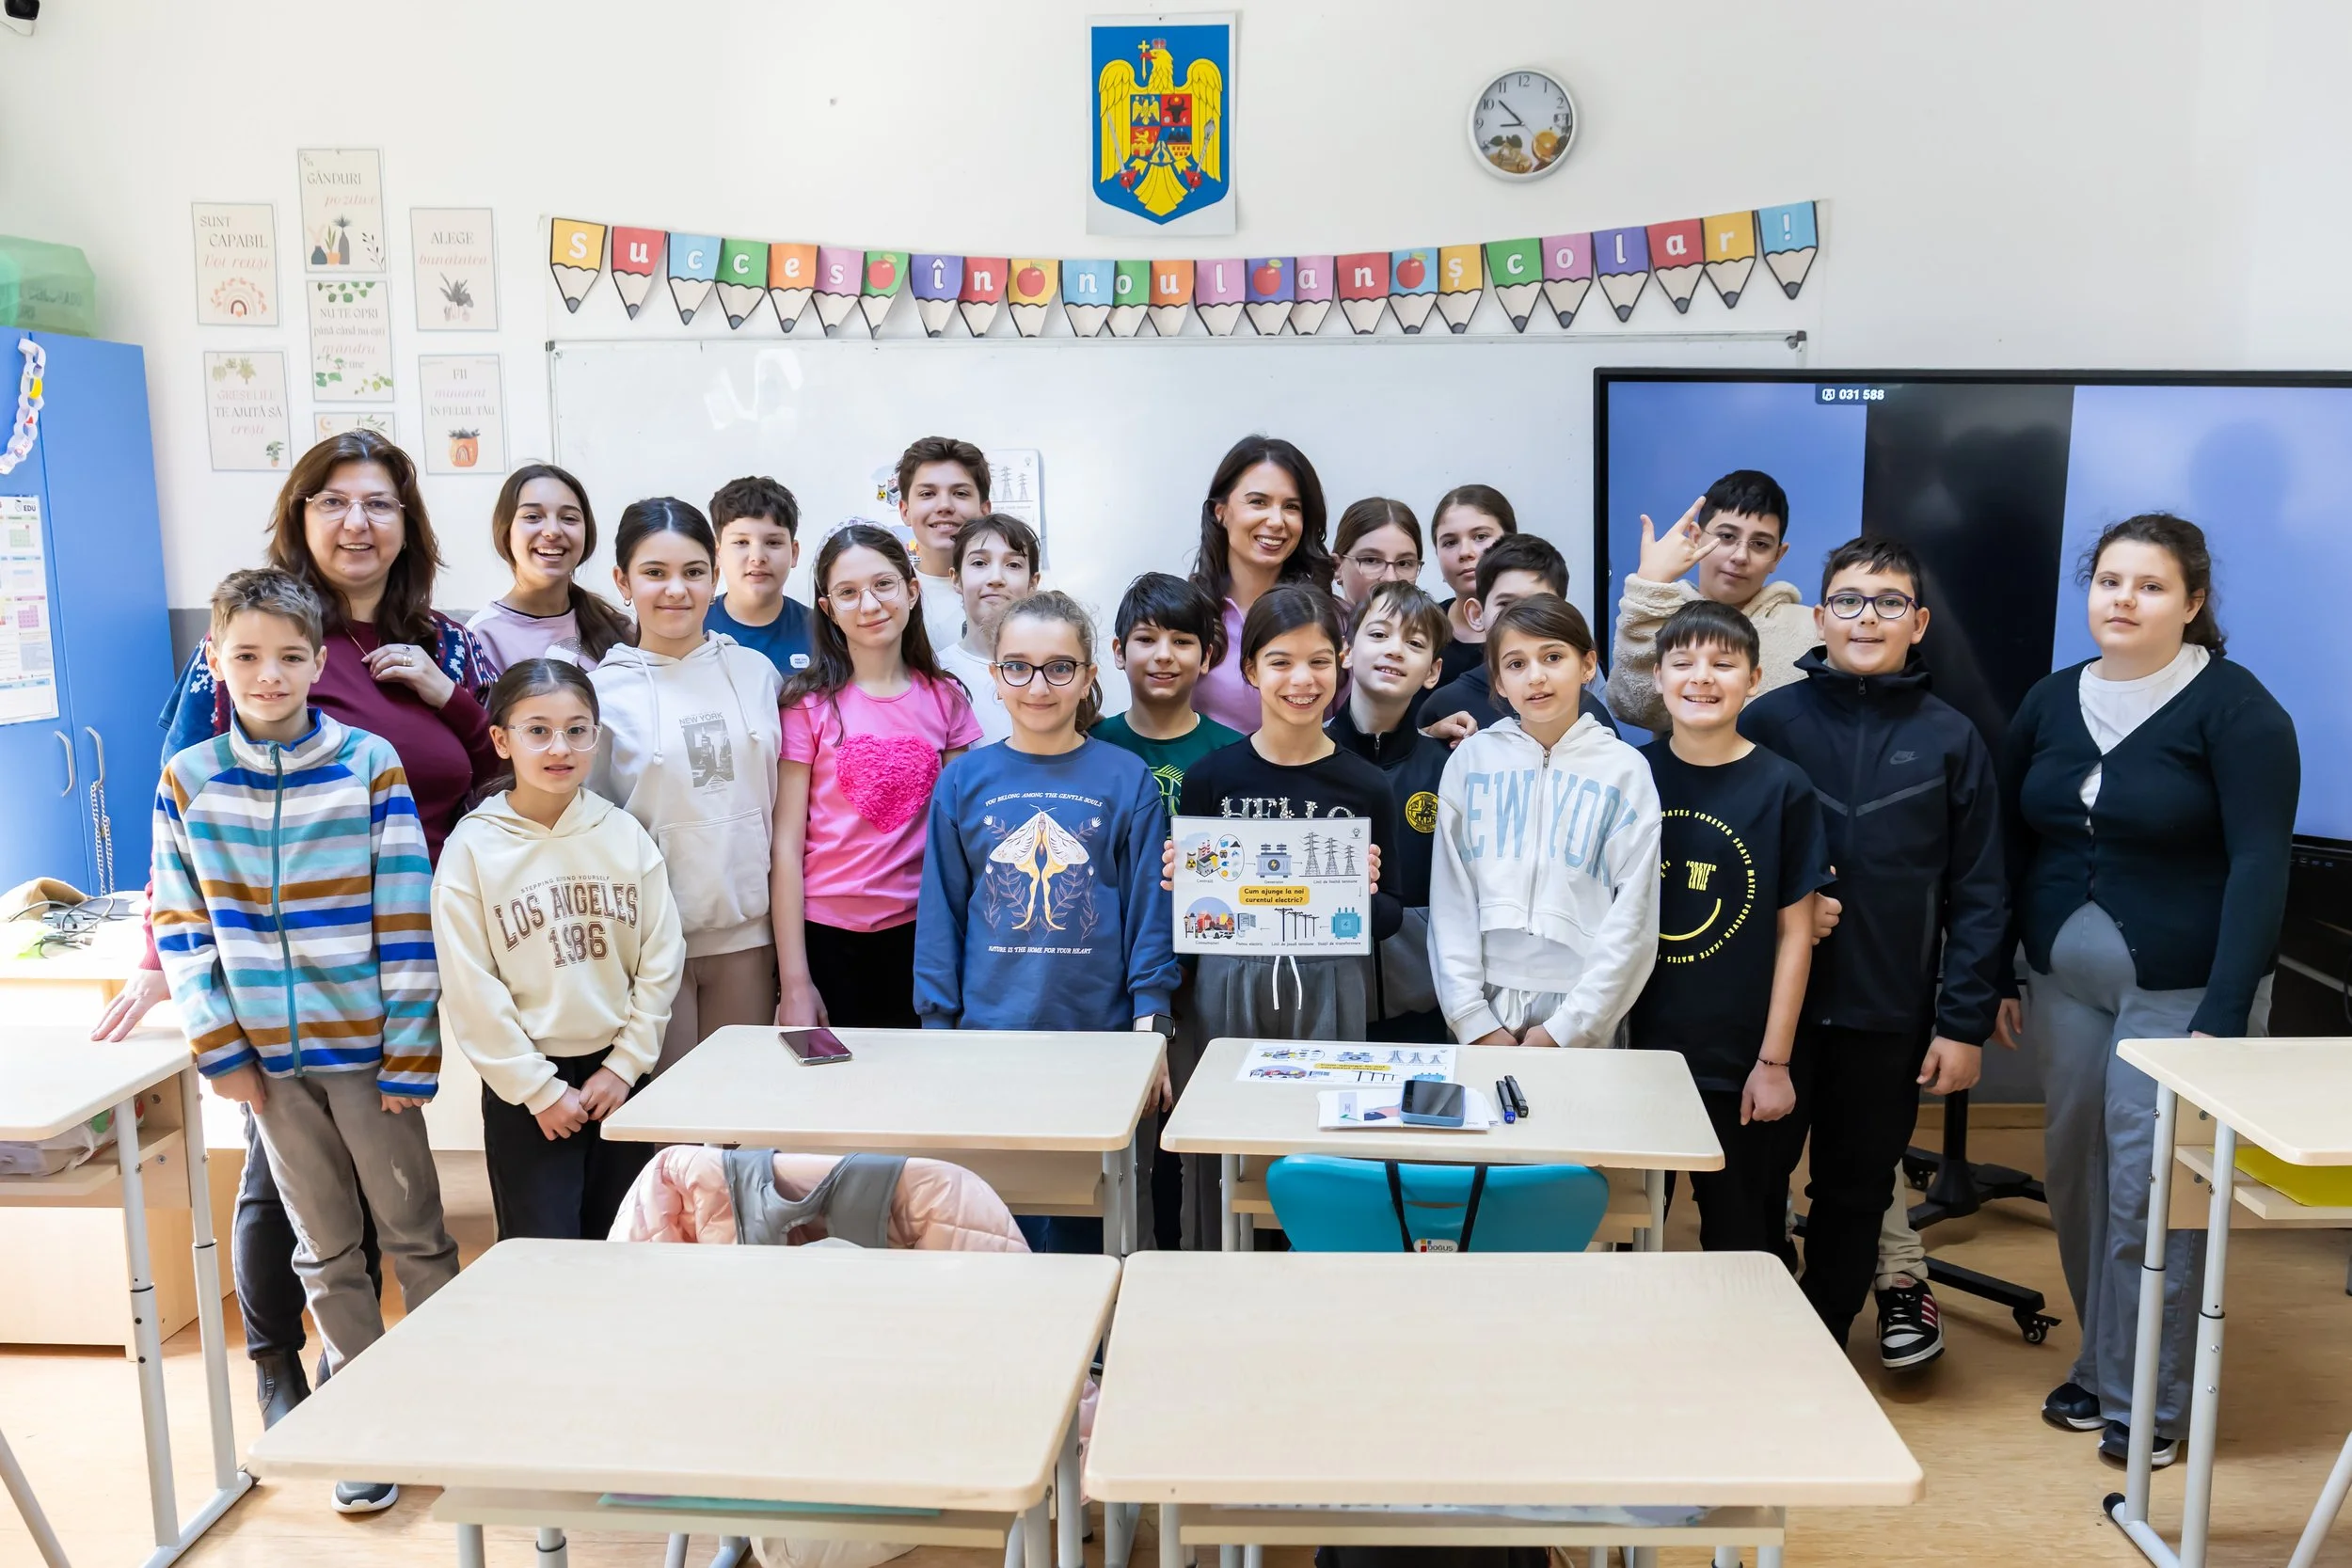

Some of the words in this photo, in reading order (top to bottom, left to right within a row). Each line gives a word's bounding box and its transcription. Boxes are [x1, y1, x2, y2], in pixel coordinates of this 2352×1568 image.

[1499, 82, 1507, 93] 11
[1518, 74, 1531, 87] 12
[1483, 99, 1494, 110] 10
[1556, 97, 1565, 109] 2
[1475, 118, 1484, 129] 9
[199, 215, 231, 229] SUNT
[209, 232, 269, 249] CAPABIL
[430, 230, 475, 245] ALEGE
[568, 231, 845, 286] Succes
[932, 259, 993, 293] în
[1077, 264, 1227, 296] noul
[1297, 264, 1375, 292] an
[1448, 213, 1793, 289] școlar!
[320, 308, 336, 319] NU
[338, 308, 351, 319] TE
[353, 308, 379, 320] OPRI
[1838, 388, 1860, 401] 031
[1862, 388, 1885, 401] 588
[215, 406, 230, 419] TE
[23, 504, 37, 513] EDU
[679, 715, 699, 726] NEW
[699, 712, 724, 722] YORK
[985, 797, 997, 807] YOU
[997, 792, 1021, 802] BELONG
[1058, 793, 1084, 801] GENTLE
[1084, 797, 1104, 808] SOULS
[1460, 768, 1535, 863] EW
[1693, 811, 1733, 836] FOREVER
[1732, 837, 1753, 865] SKATE
[1686, 860, 1717, 872] FOREVER
[520, 878, 555, 895] STEPPING
[579, 874, 611, 882] YOURSELF
[1746, 869, 1756, 899] MATES
[493, 893, 547, 952] LOS
[548, 881, 640, 929] ANGELES
[1724, 903, 1752, 939] FOREVER
[1699, 940, 1724, 959] SKATE
[1667, 955, 1694, 964] MATES
